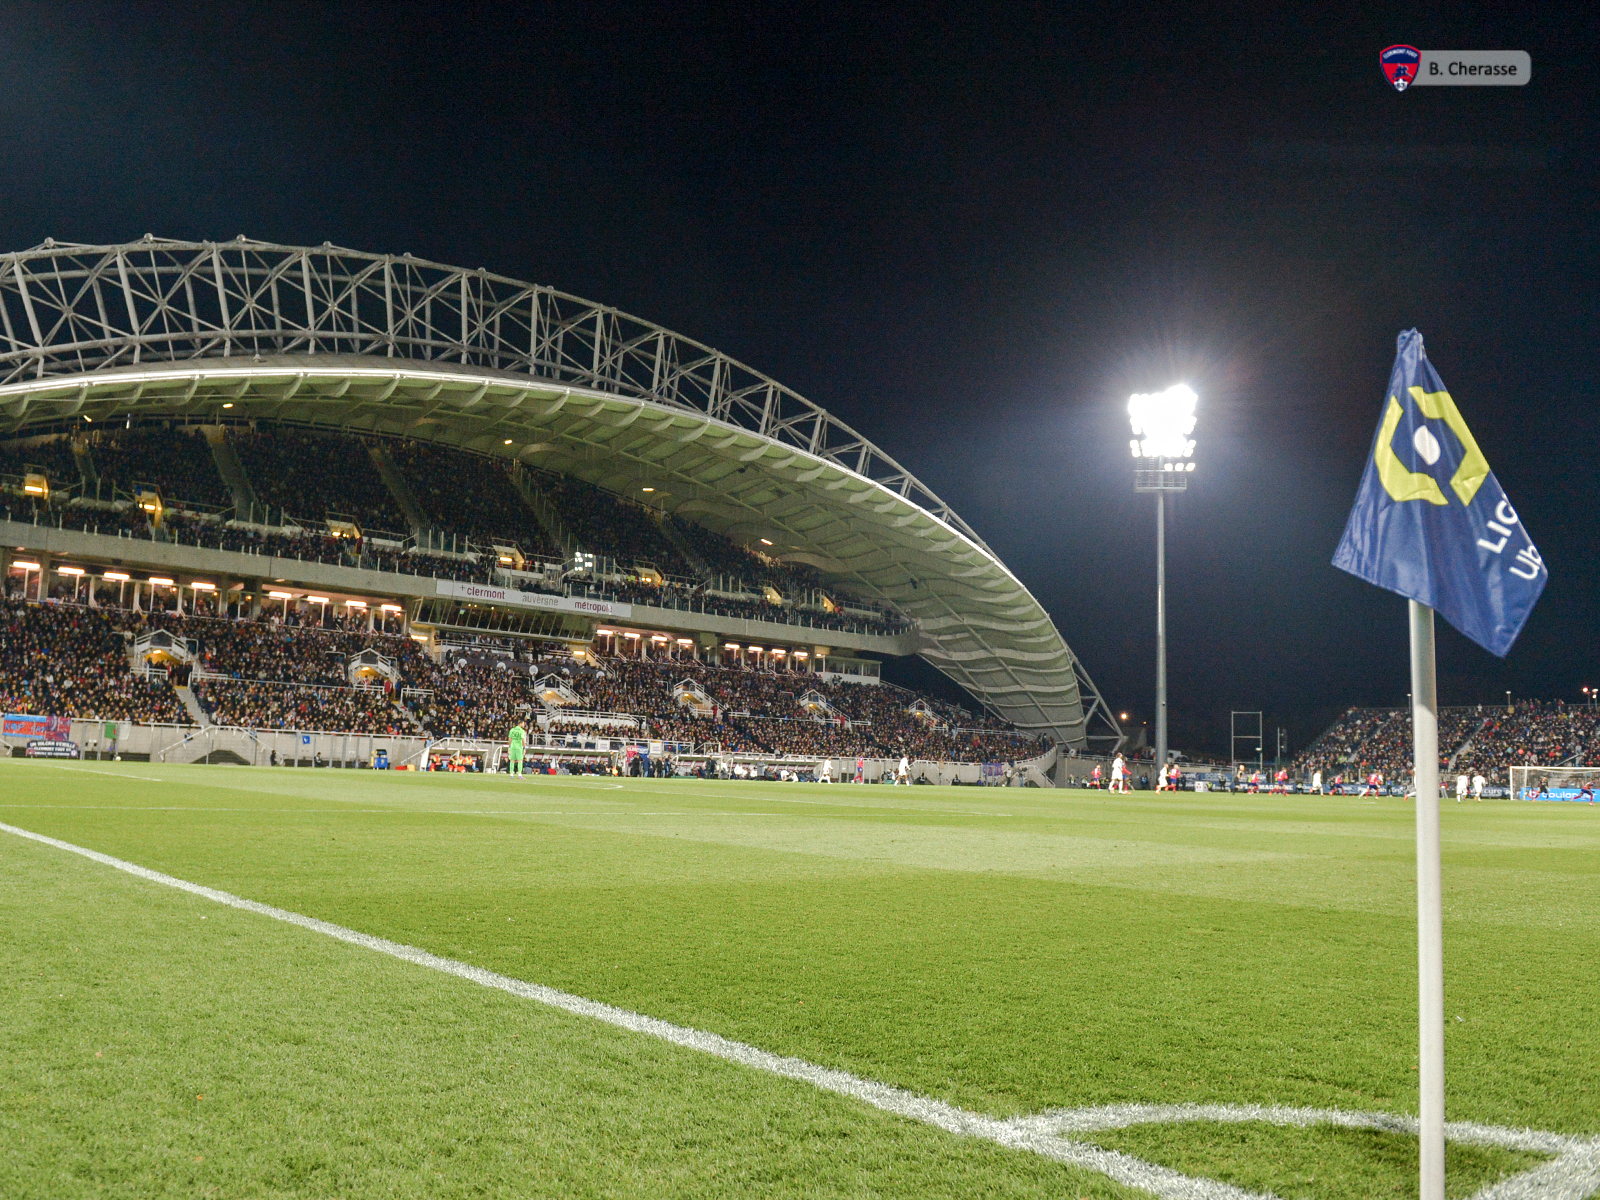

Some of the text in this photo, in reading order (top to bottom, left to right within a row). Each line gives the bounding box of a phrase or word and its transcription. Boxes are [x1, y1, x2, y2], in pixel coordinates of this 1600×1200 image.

[1477, 494, 1518, 554] LIG
[467, 586, 613, 614] clermont auvergne métropole
